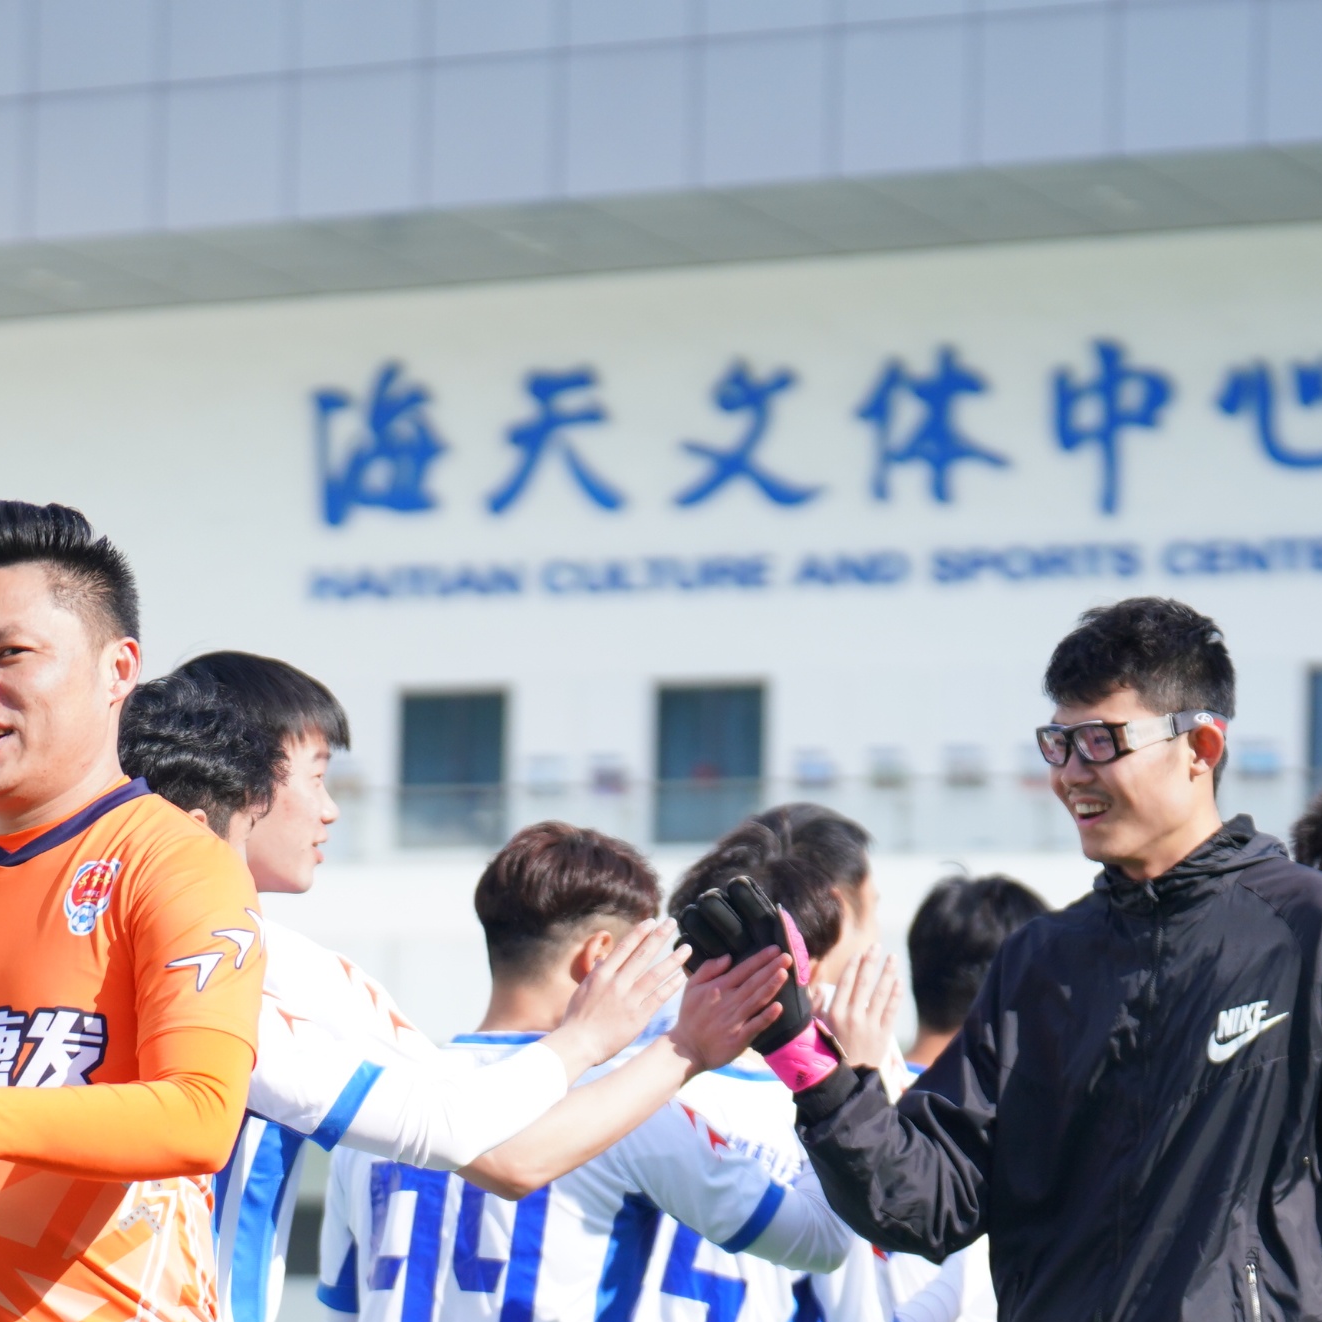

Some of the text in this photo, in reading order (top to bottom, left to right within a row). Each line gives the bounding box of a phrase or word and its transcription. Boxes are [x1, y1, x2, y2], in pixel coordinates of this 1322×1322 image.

[309, 565, 523, 600] HAITIAN
[540, 557, 769, 595] CULTURE
[794, 553, 909, 589] AND
[930, 544, 1142, 585] SPORTS
[1216, 1000, 1269, 1039] NIKE
